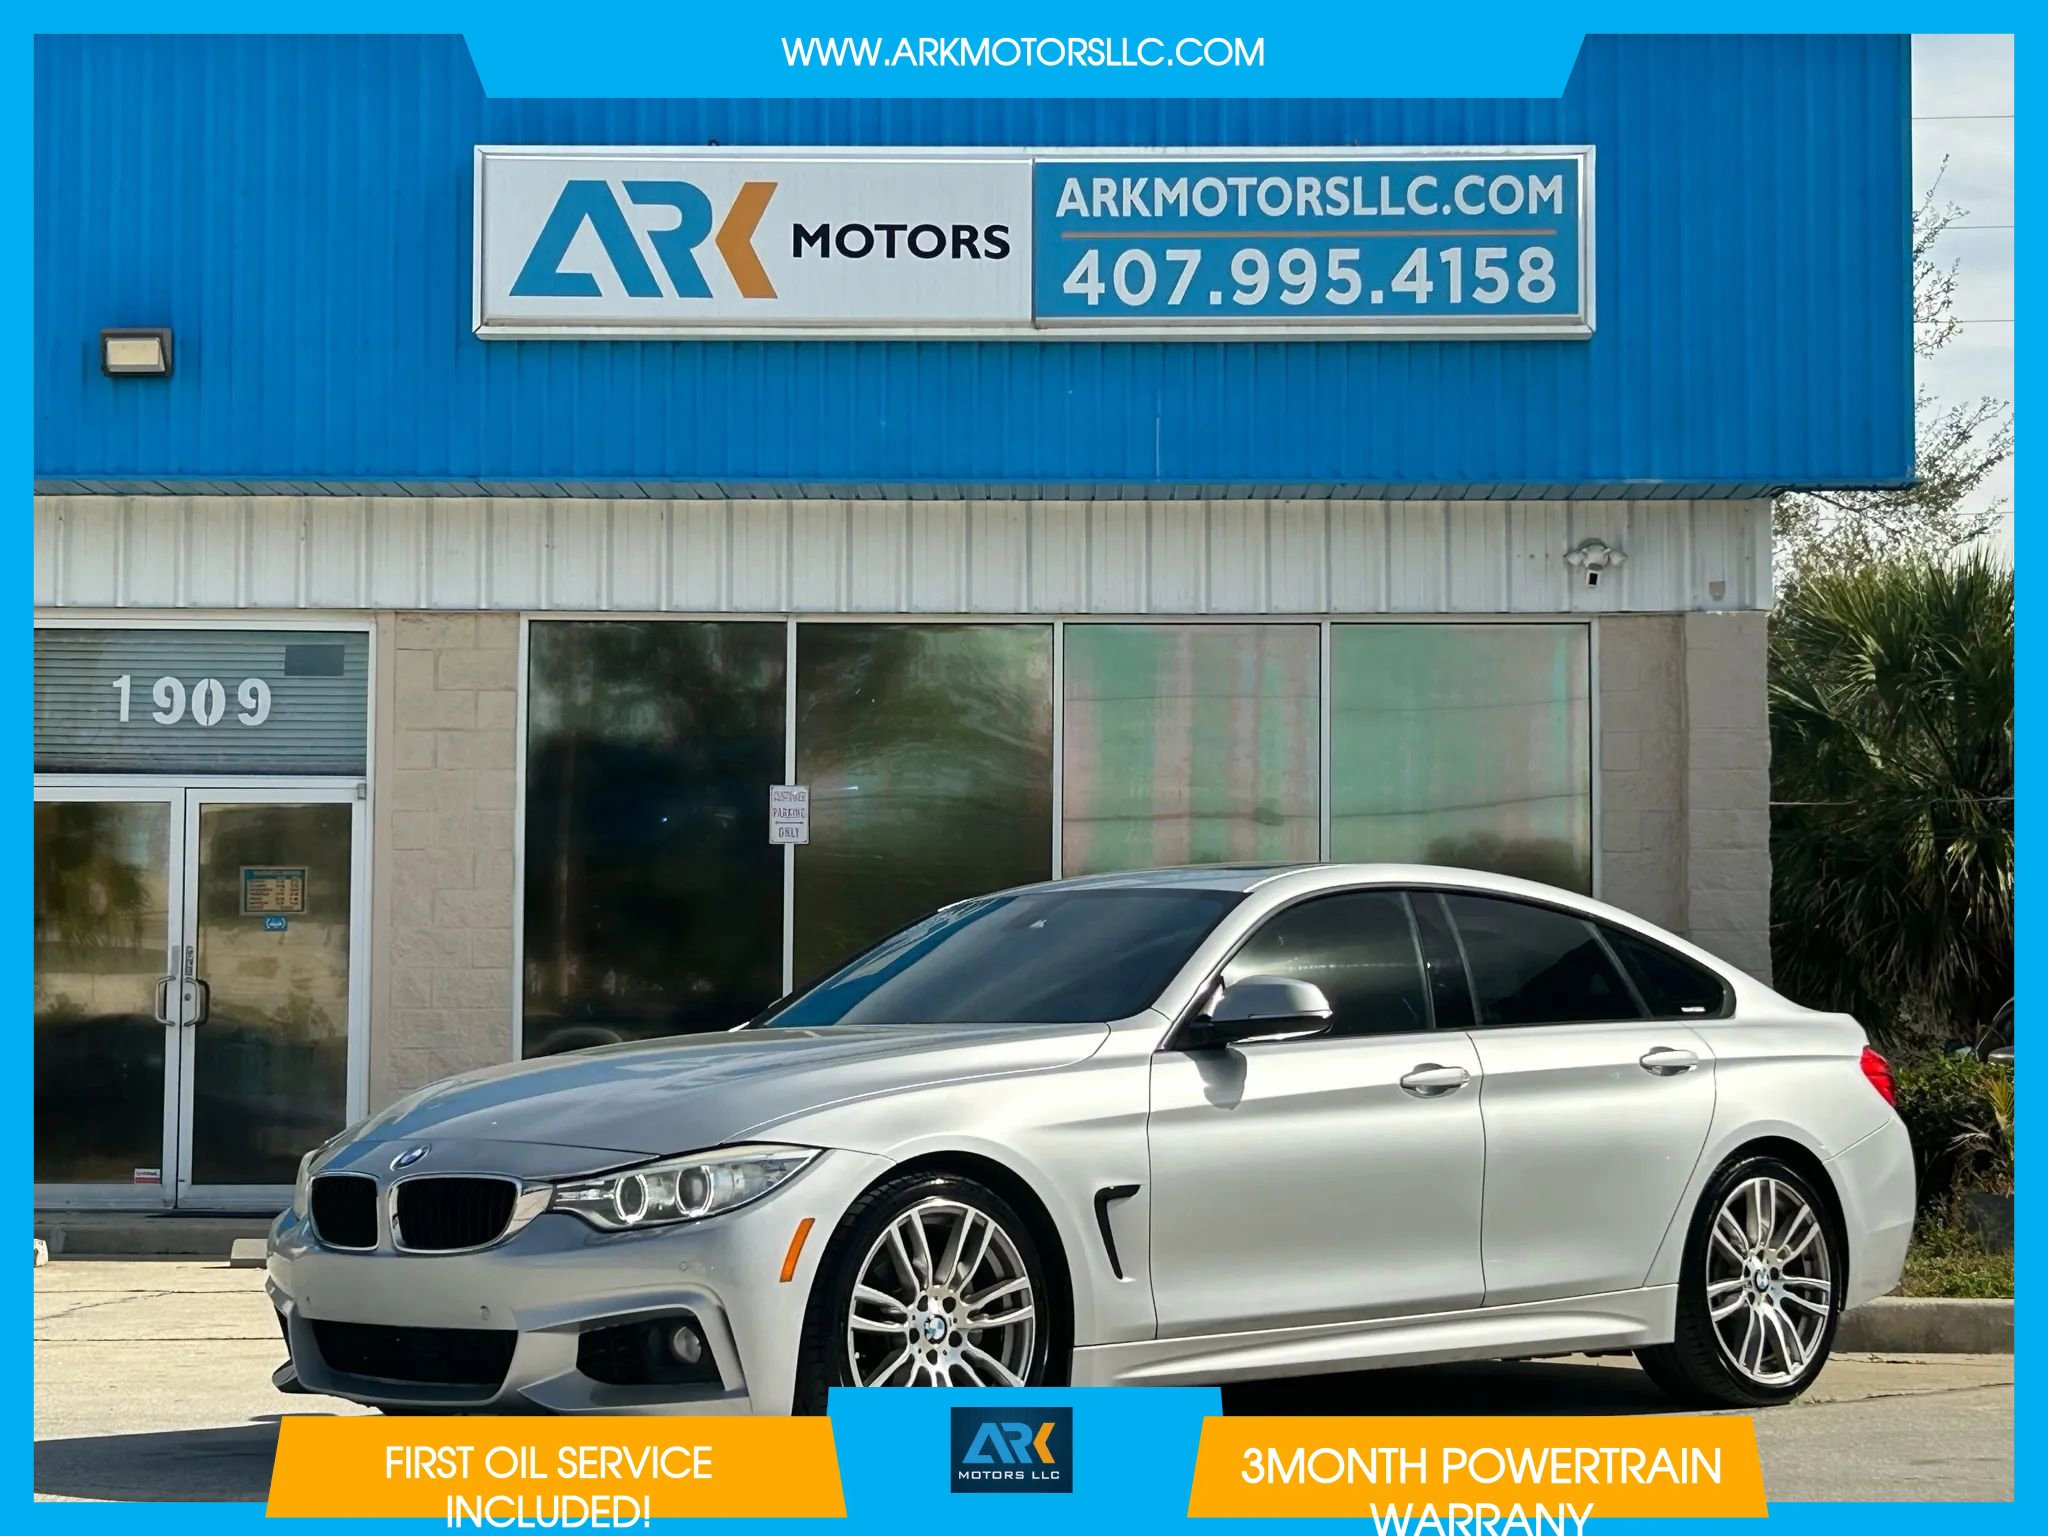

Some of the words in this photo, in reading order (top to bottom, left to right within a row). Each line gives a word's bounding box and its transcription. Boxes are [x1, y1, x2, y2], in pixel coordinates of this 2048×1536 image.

[1055, 174, 1563, 217] ARKMOTORSLLC.COM
[510, 179, 777, 299] ARK
[792, 223, 1010, 260] MOTORS
[1062, 246, 1556, 306] 407.995.4158
[112, 674, 272, 727] 1909
[778, 827, 799, 838] ONLY
